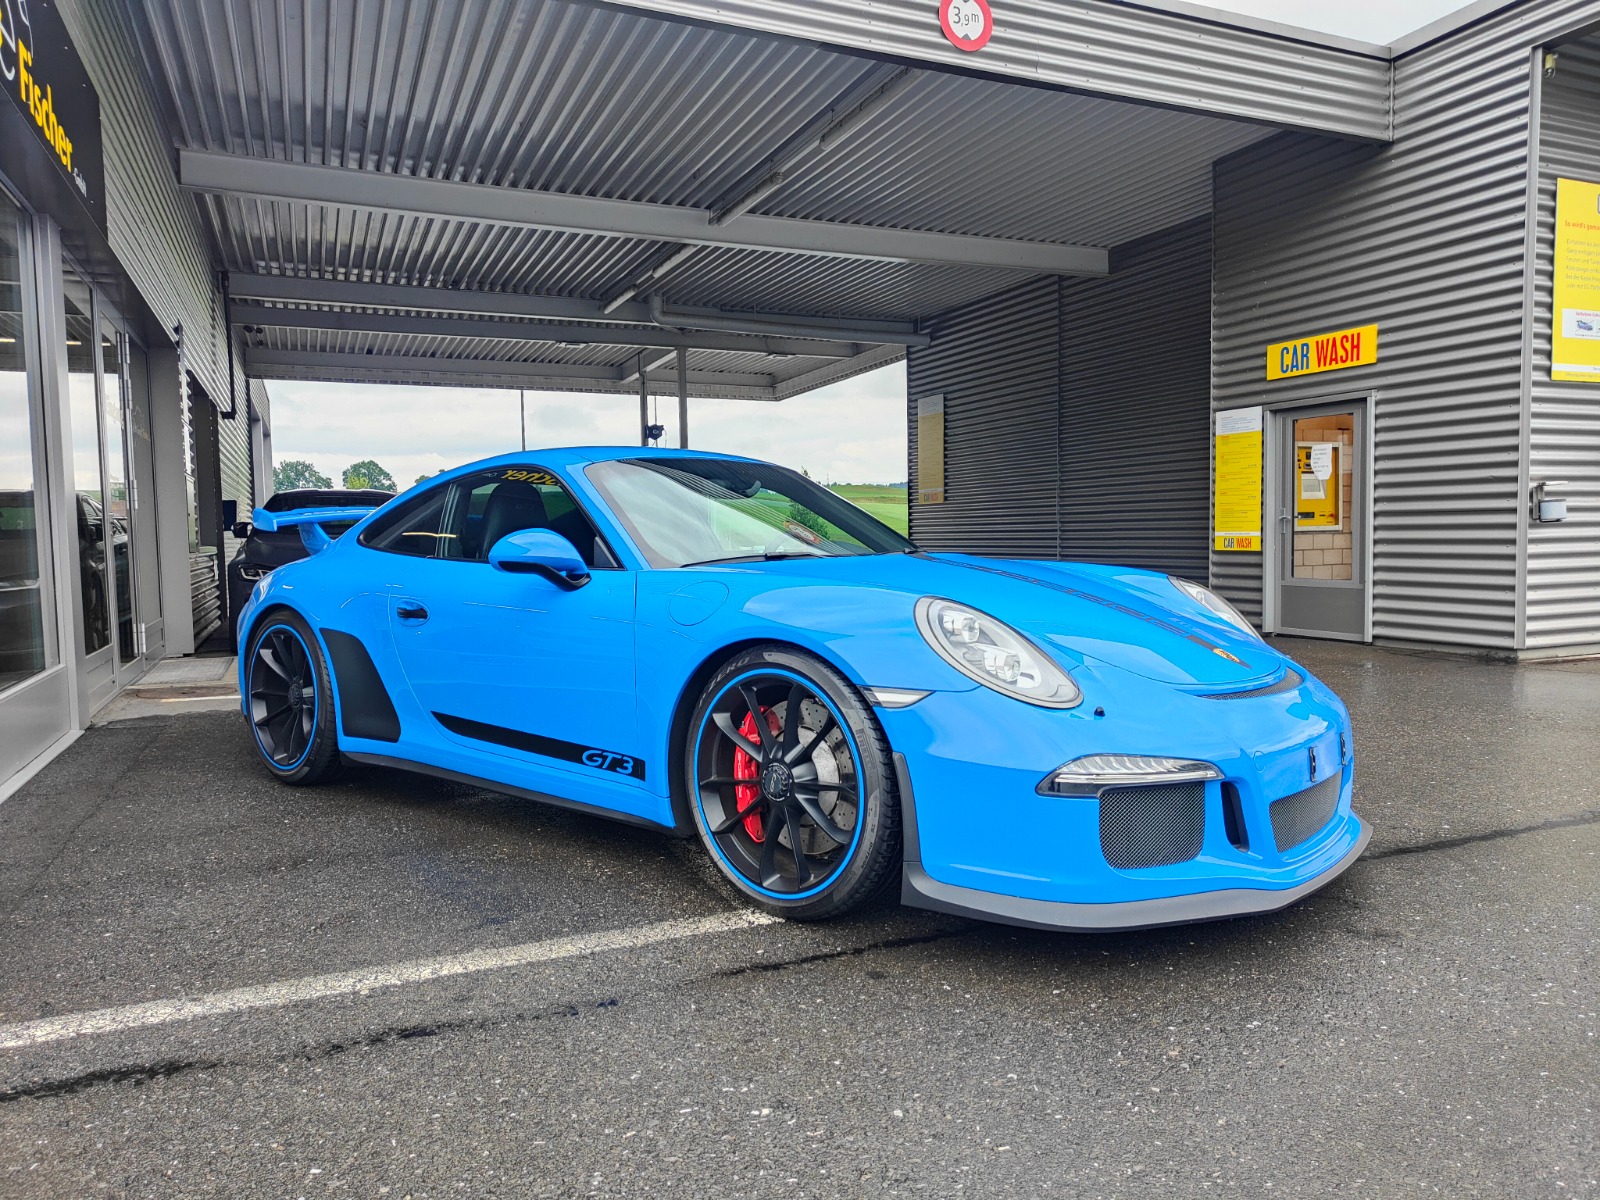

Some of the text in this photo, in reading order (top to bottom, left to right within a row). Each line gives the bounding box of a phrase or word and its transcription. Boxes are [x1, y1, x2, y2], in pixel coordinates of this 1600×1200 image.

[18, 38, 73, 173] Fischer
[1280, 332, 1361, 374] CAR WASH
[1223, 537, 1252, 549] CAR WASH
[581, 749, 634, 775] GT3
